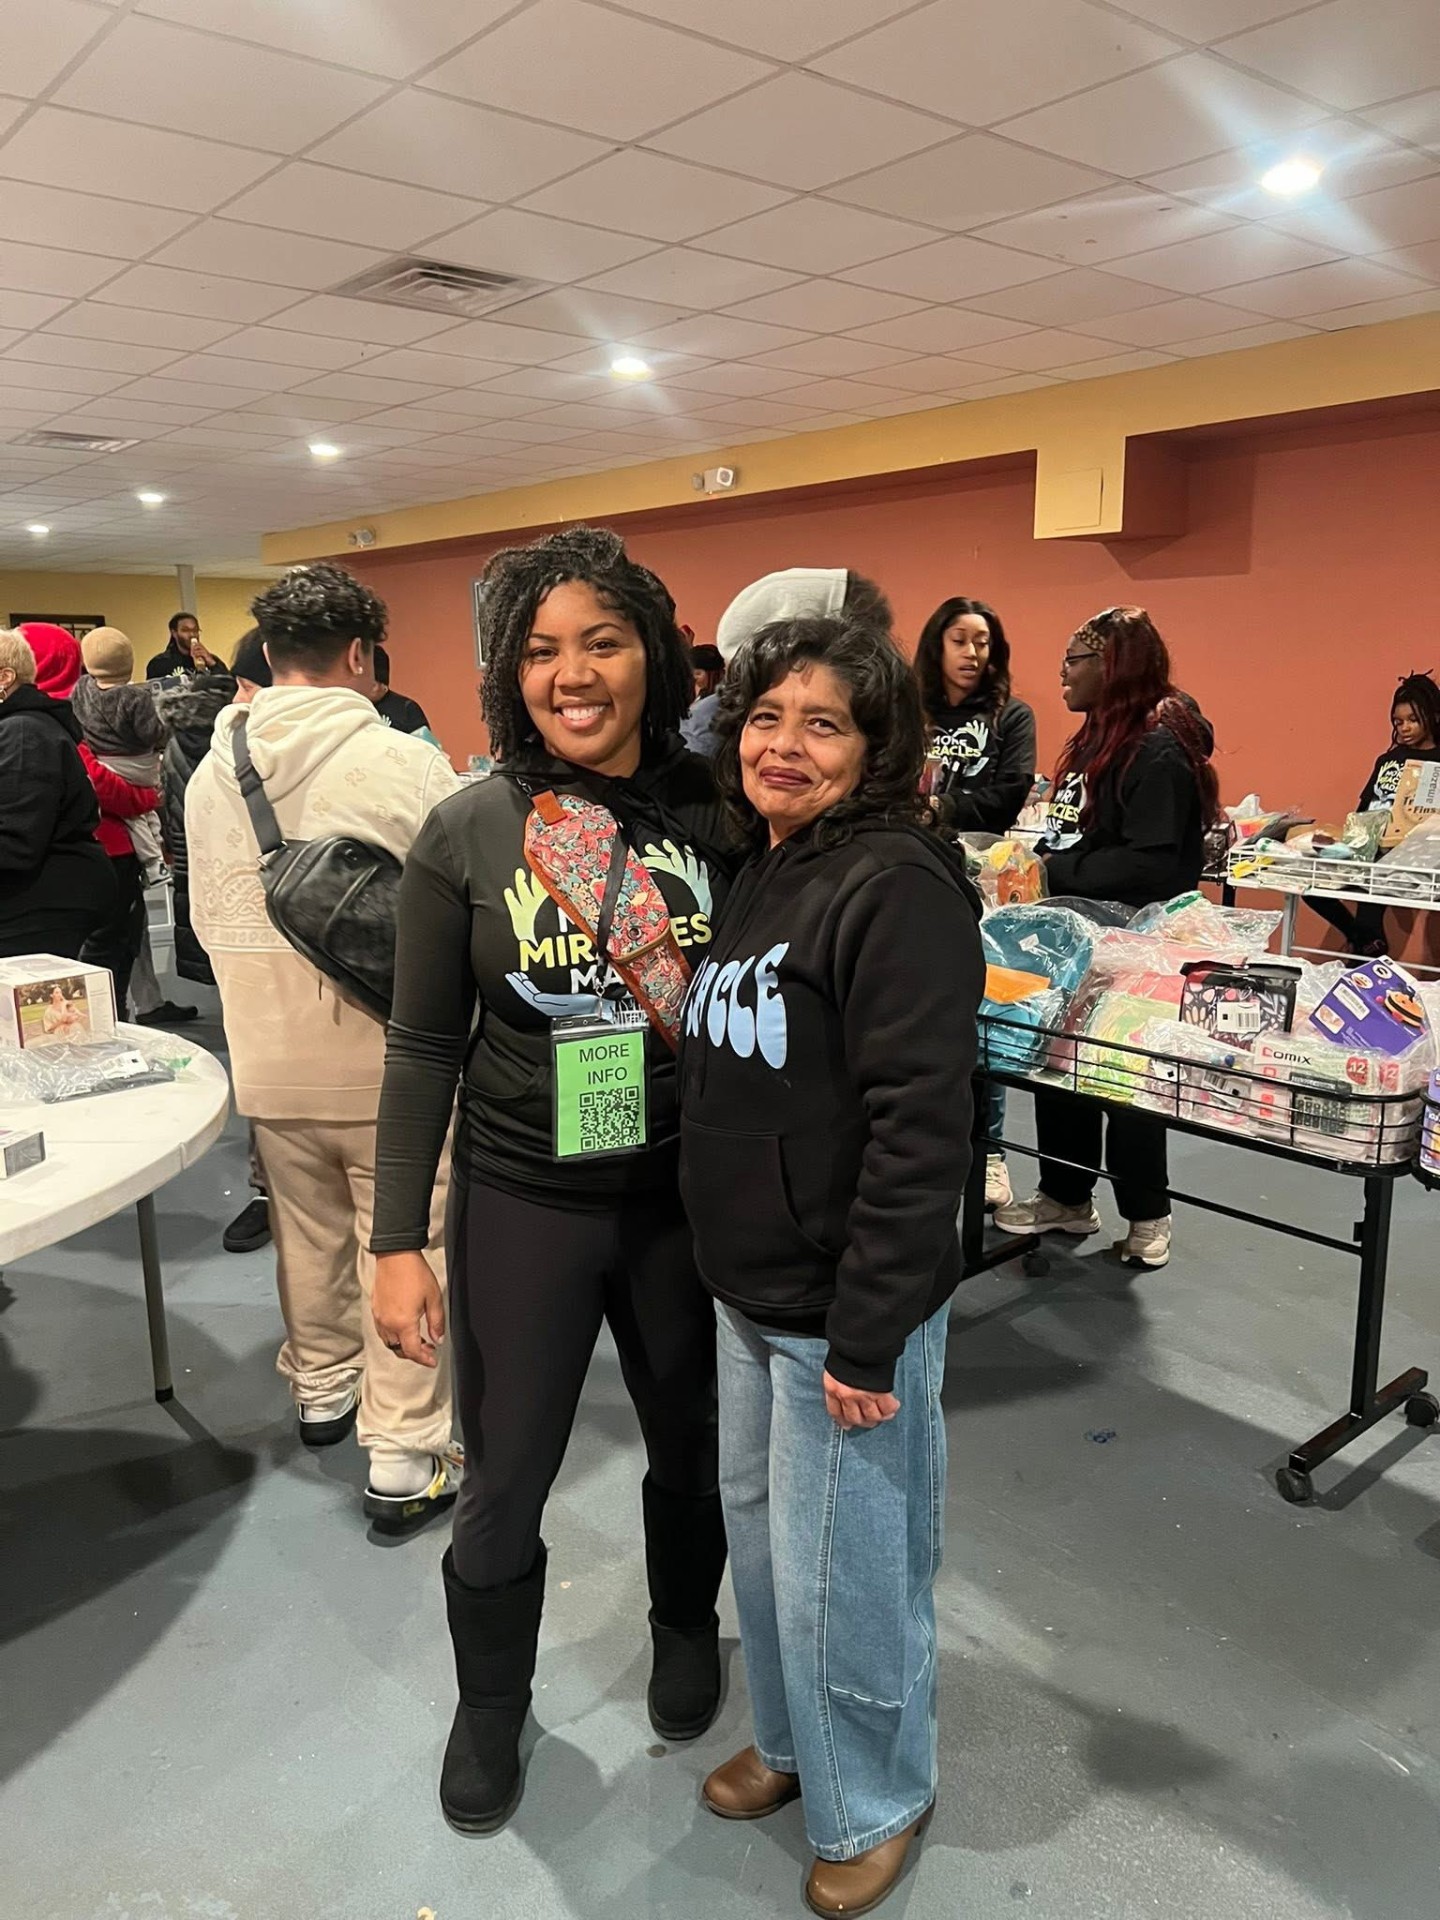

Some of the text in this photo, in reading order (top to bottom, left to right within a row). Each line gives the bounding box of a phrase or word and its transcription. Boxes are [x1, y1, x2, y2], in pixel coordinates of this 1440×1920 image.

[1426, 766, 1440, 804] amazon
[579, 1043, 630, 1063] MORE
[588, 1066, 628, 1085] INFO
[1348, 1061, 1366, 1074] 12
